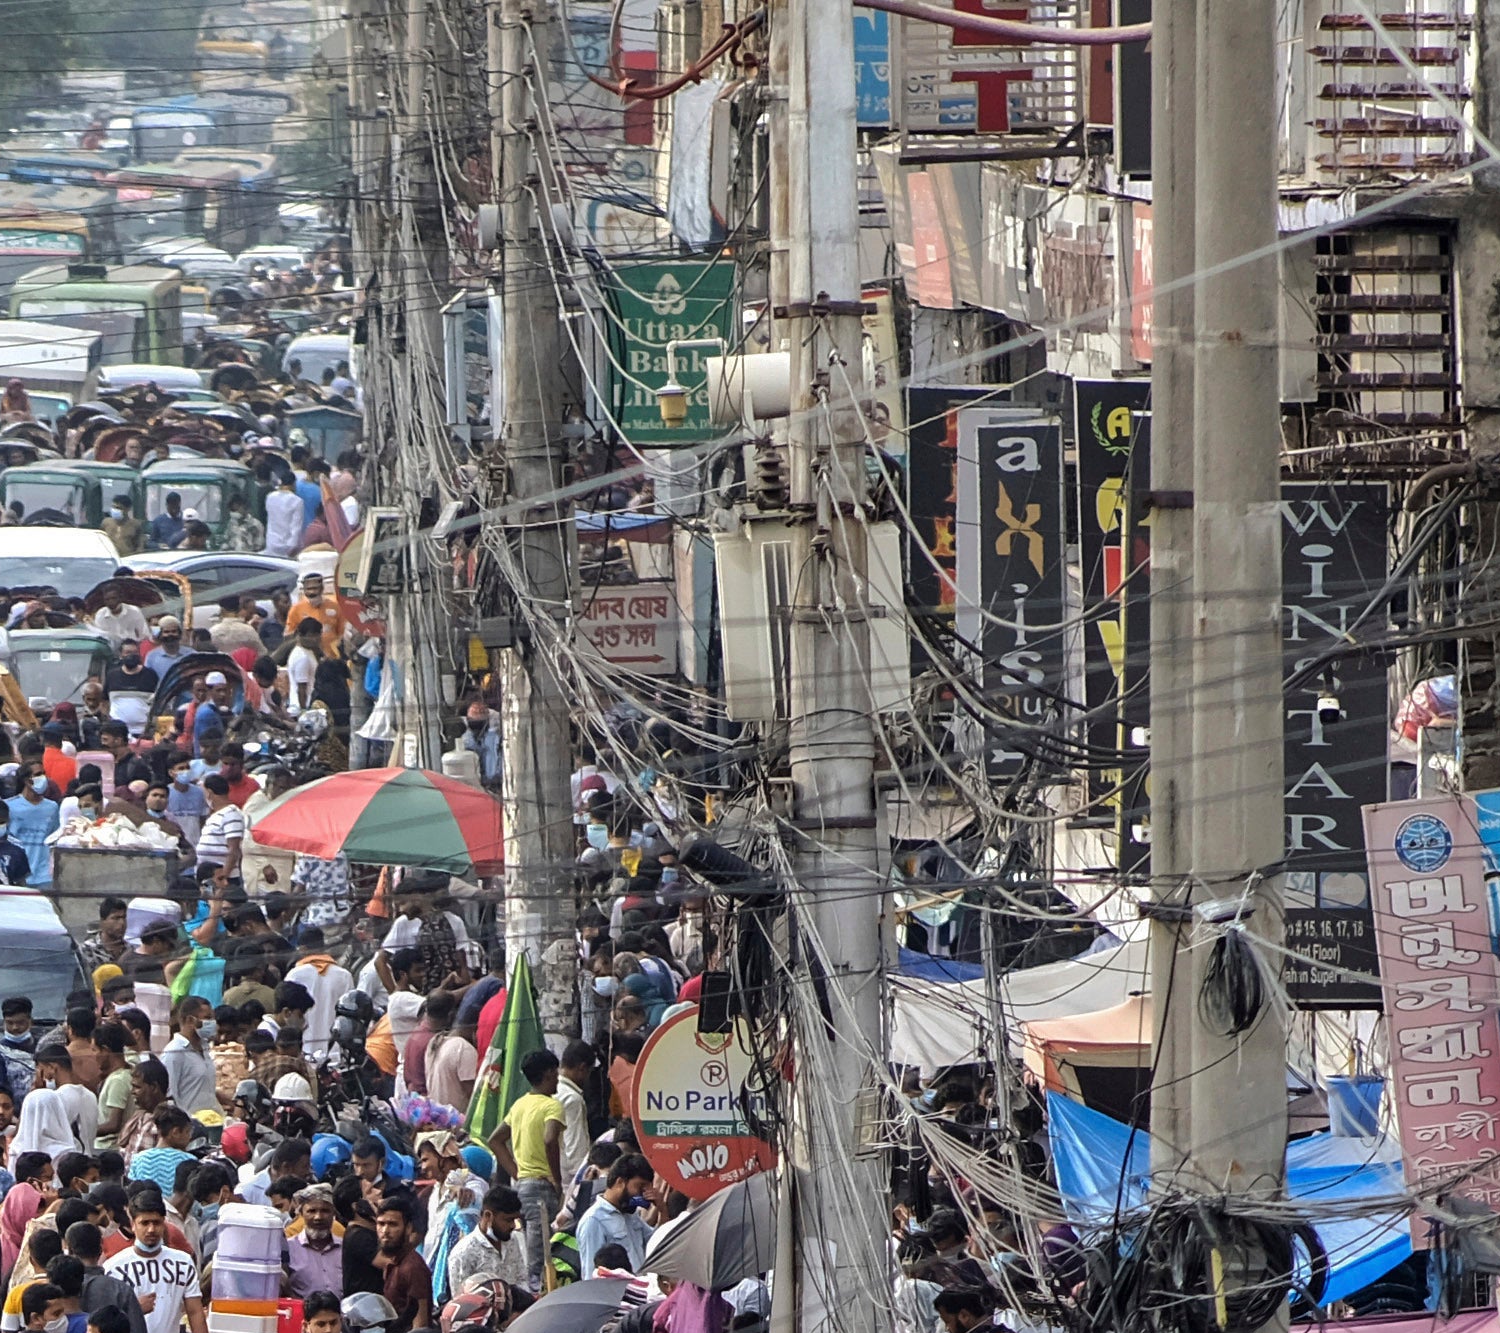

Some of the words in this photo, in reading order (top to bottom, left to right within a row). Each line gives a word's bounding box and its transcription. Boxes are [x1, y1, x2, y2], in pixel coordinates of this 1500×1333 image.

[623, 318, 719, 342] Uttara
[630, 350, 708, 374] Bank
[613, 383, 709, 407] Lite
[1320, 920, 1334, 938] 16,
[1336, 920, 1350, 938] 17,
[1353, 920, 1364, 937] 18
[1310, 967, 1338, 987] Super
[647, 1091, 679, 1111] No
[686, 1090, 765, 1111] Parkn
[656, 1121, 696, 1137] ট্রাফিক
[699, 1122, 733, 1136] রমনা
[676, 1143, 729, 1180] MOJO
[110, 1259, 196, 1287] XPOSED
